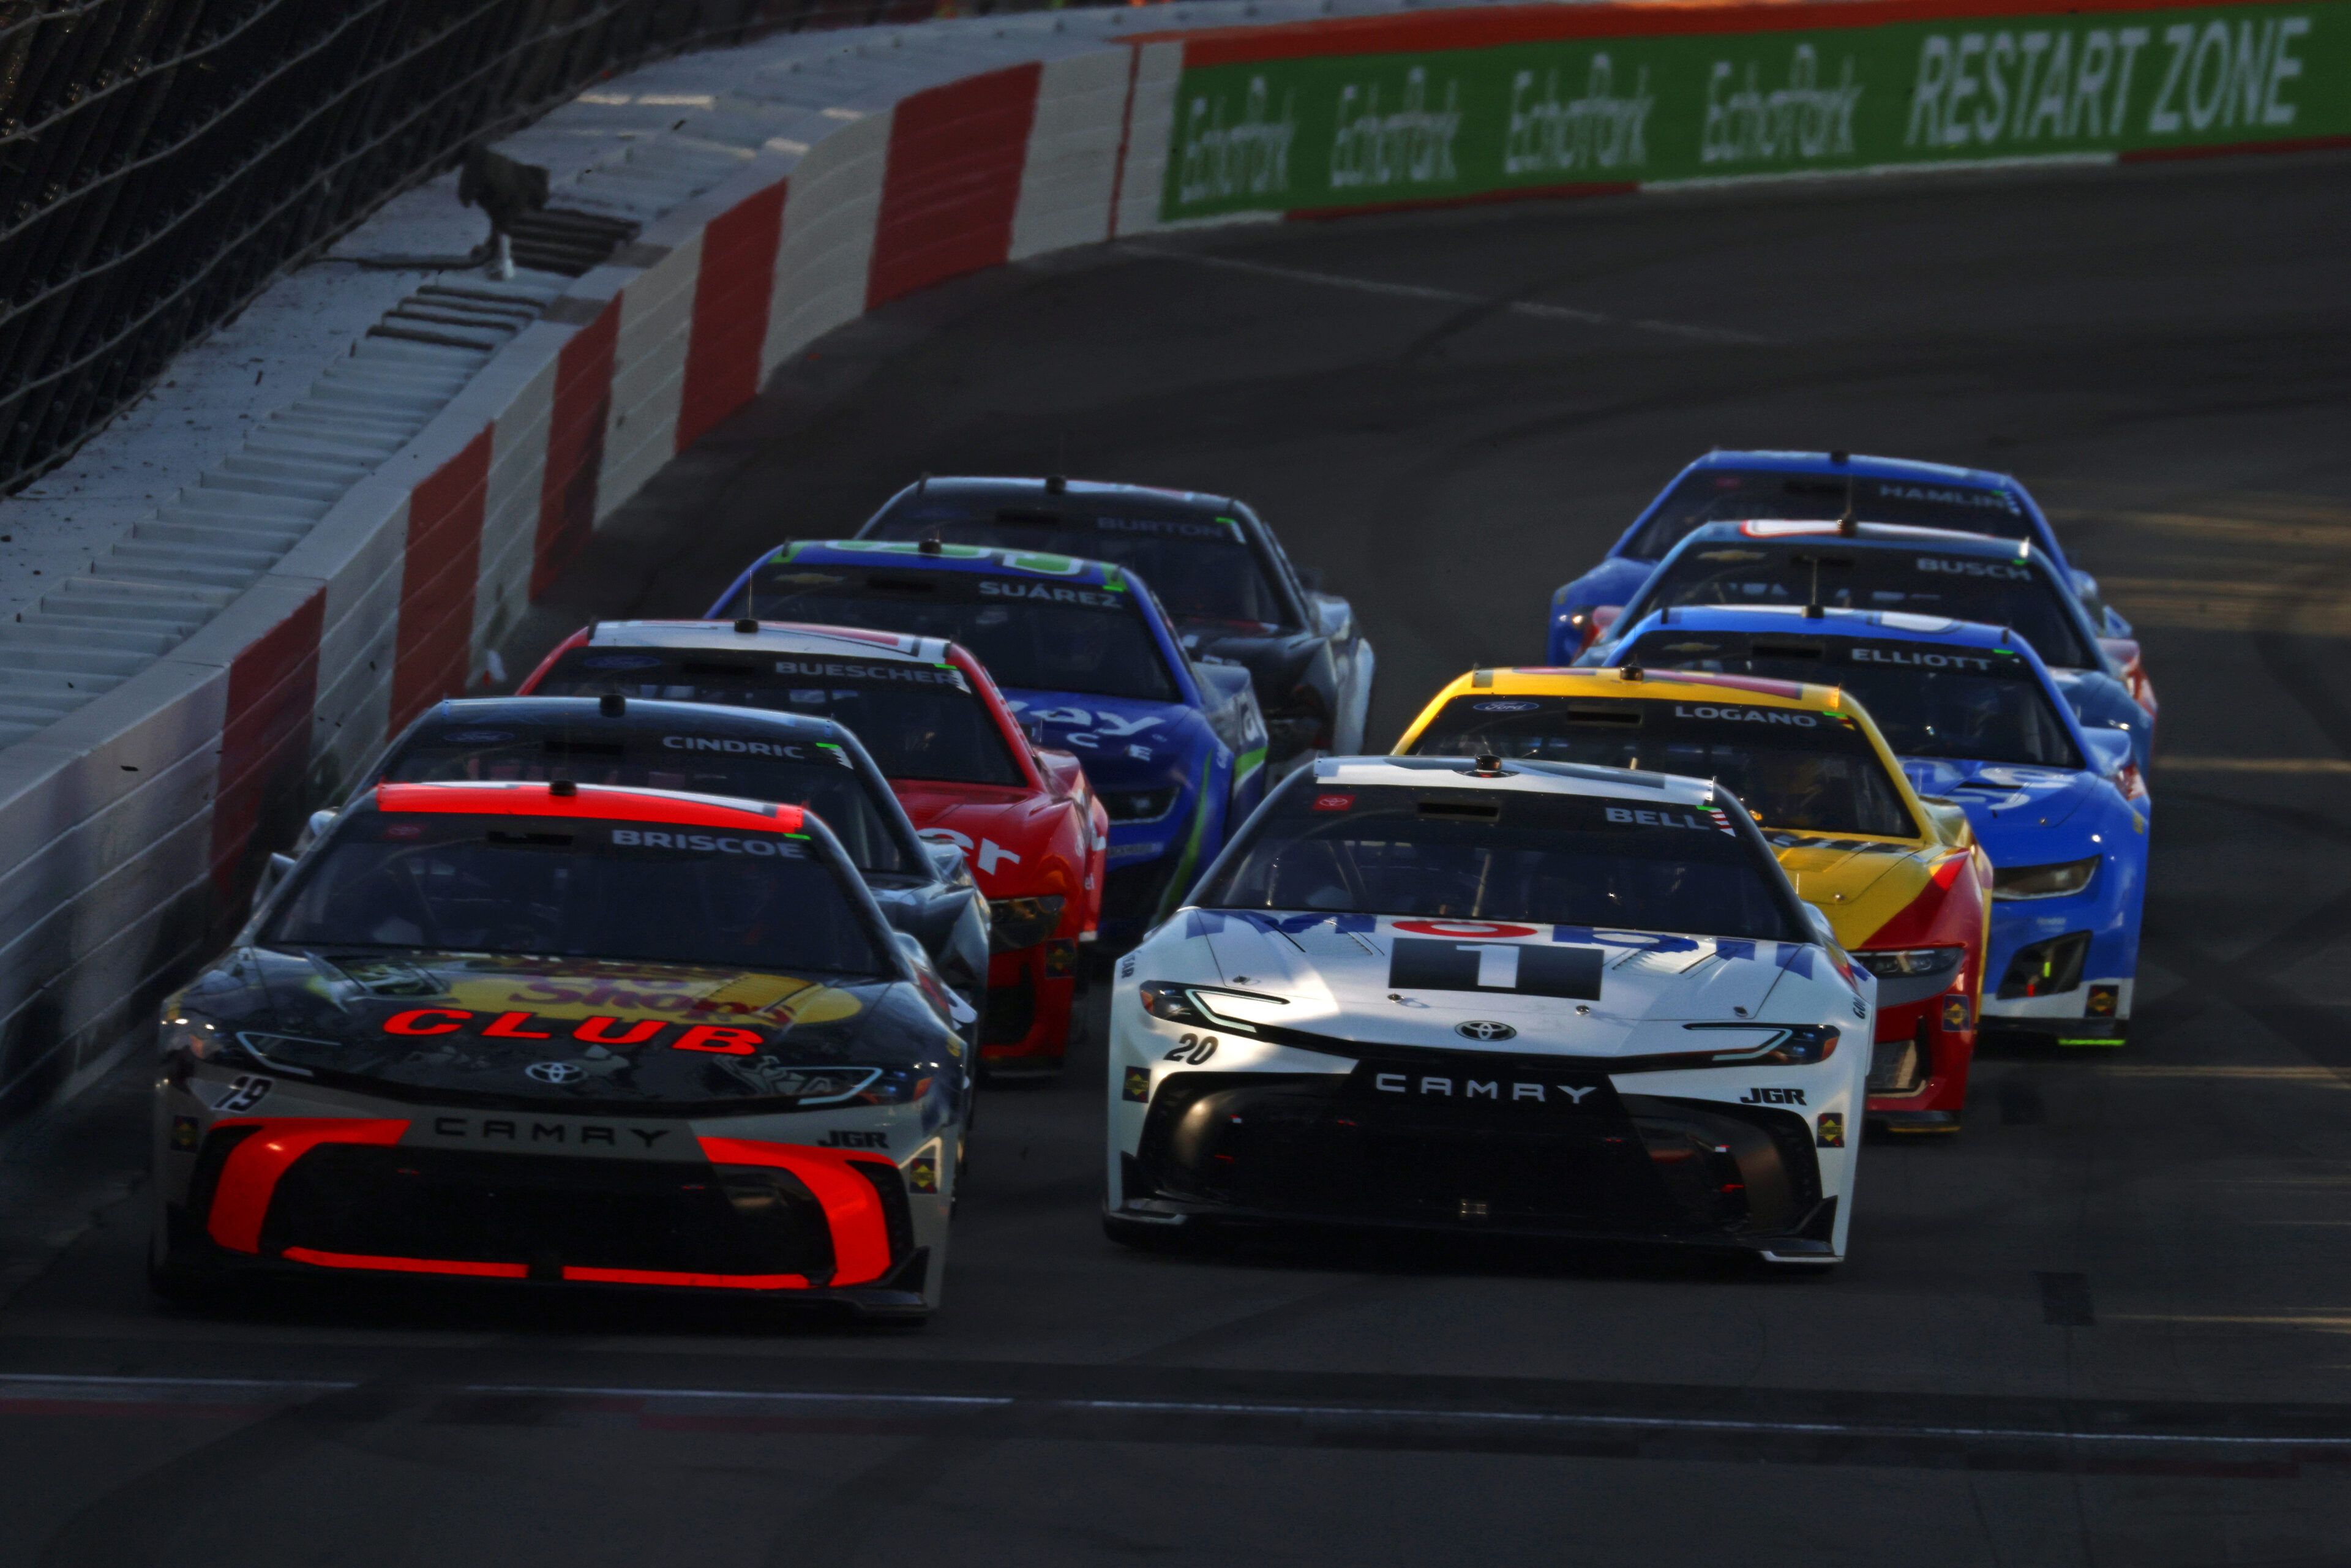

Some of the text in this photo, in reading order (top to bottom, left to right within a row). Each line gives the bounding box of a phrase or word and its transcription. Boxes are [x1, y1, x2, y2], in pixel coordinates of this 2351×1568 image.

[1904, 16, 2311, 147] RESTART ZONE
[1916, 558, 2032, 580] BUSCH
[978, 582, 1124, 609] SUÁREZ
[775, 661, 956, 685] BUESCHER
[1851, 648, 1992, 671] ELLIOTT
[1675, 705, 1817, 728] LOGANO
[663, 736, 805, 759] CINDRIC
[1605, 807, 1711, 830] BELL
[612, 829, 806, 858] BRISCOE
[1455, 944, 1520, 989] 1
[382, 1008, 764, 1057] CLUB
[1163, 1033, 1219, 1065] 20
[214, 1076, 273, 1112] 19
[1375, 1073, 1598, 1104] CAMRY
[1740, 1088, 1807, 1106] JGR
[435, 1117, 670, 1149] CAMRY
[817, 1130, 890, 1149] JGR
